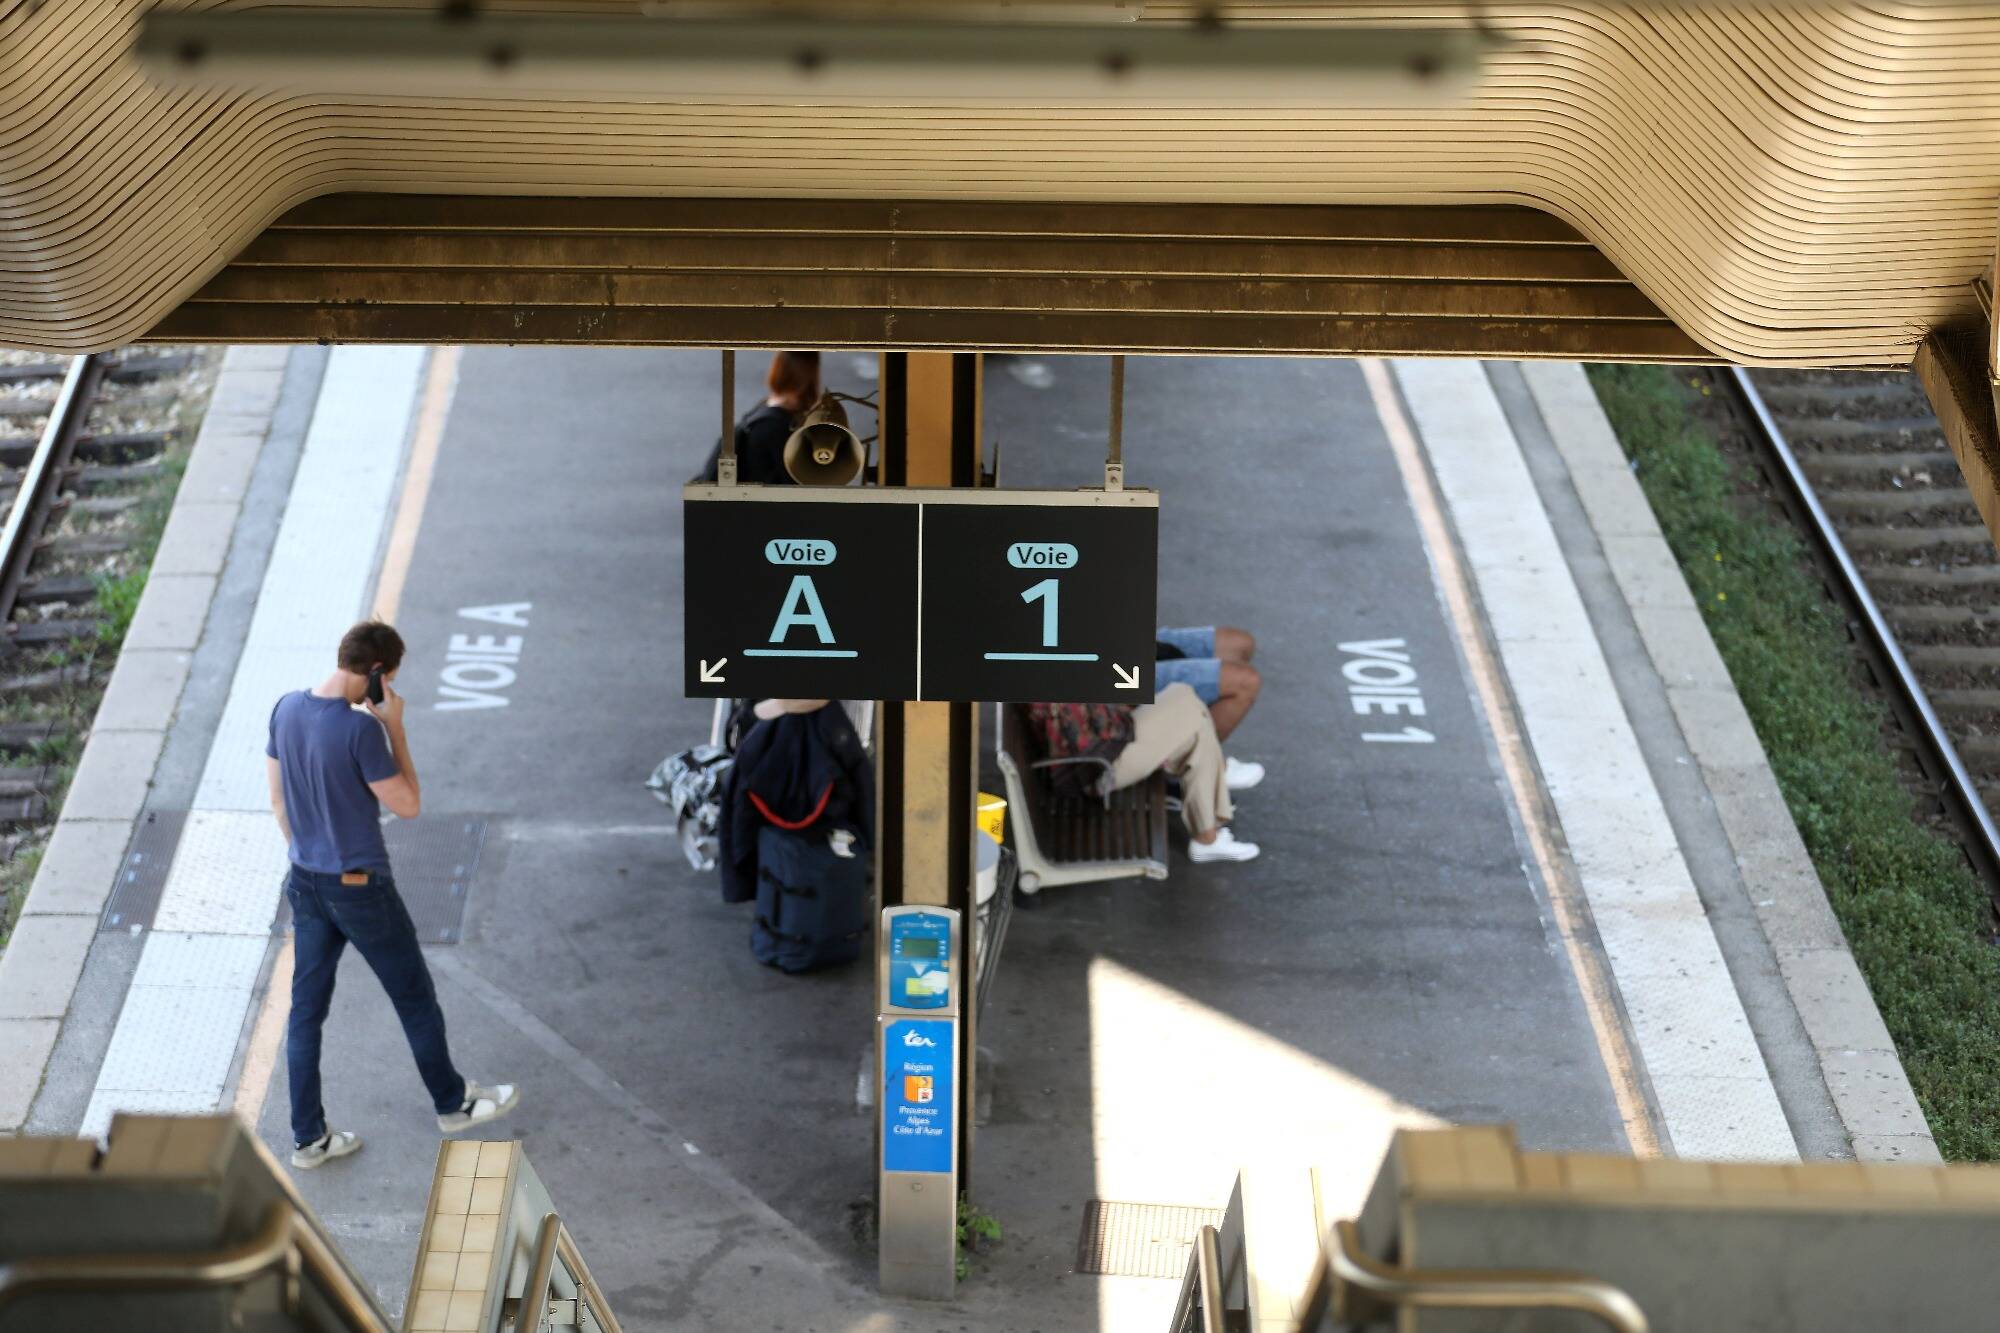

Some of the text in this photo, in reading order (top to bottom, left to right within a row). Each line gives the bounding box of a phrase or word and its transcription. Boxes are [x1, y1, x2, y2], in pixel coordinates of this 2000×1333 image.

[773, 541, 827, 562] Voie
[1015, 545, 1069, 566] Voie
[768, 574, 837, 645] A
[1020, 578, 1060, 648] 1
[433, 602, 532, 711] VOIE A
[1336, 638, 1436, 743] VOIE 1
